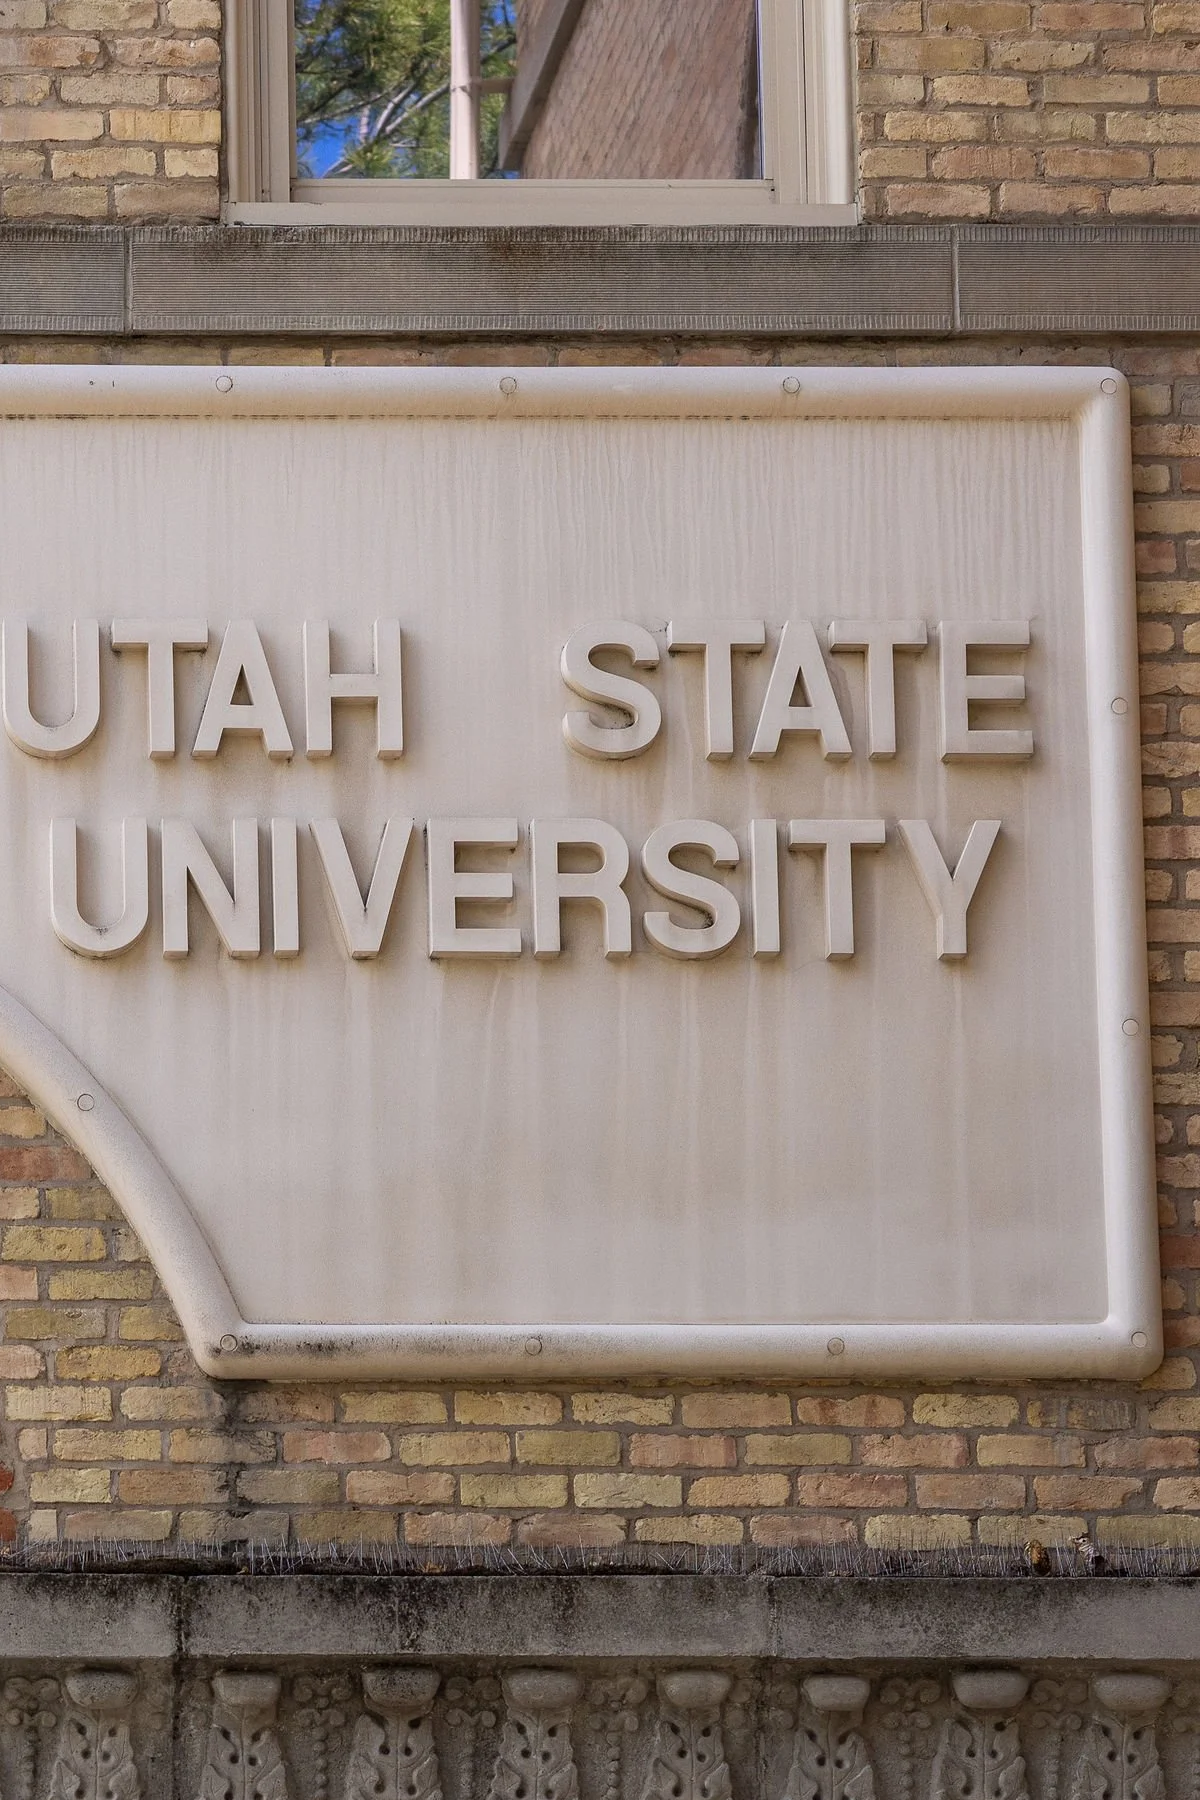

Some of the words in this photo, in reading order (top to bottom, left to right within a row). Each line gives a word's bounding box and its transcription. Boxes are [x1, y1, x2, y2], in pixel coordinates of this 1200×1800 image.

[1, 618, 404, 761] UTAH
[560, 618, 1035, 763] STATE
[49, 816, 1002, 962] UNIVERSITY
